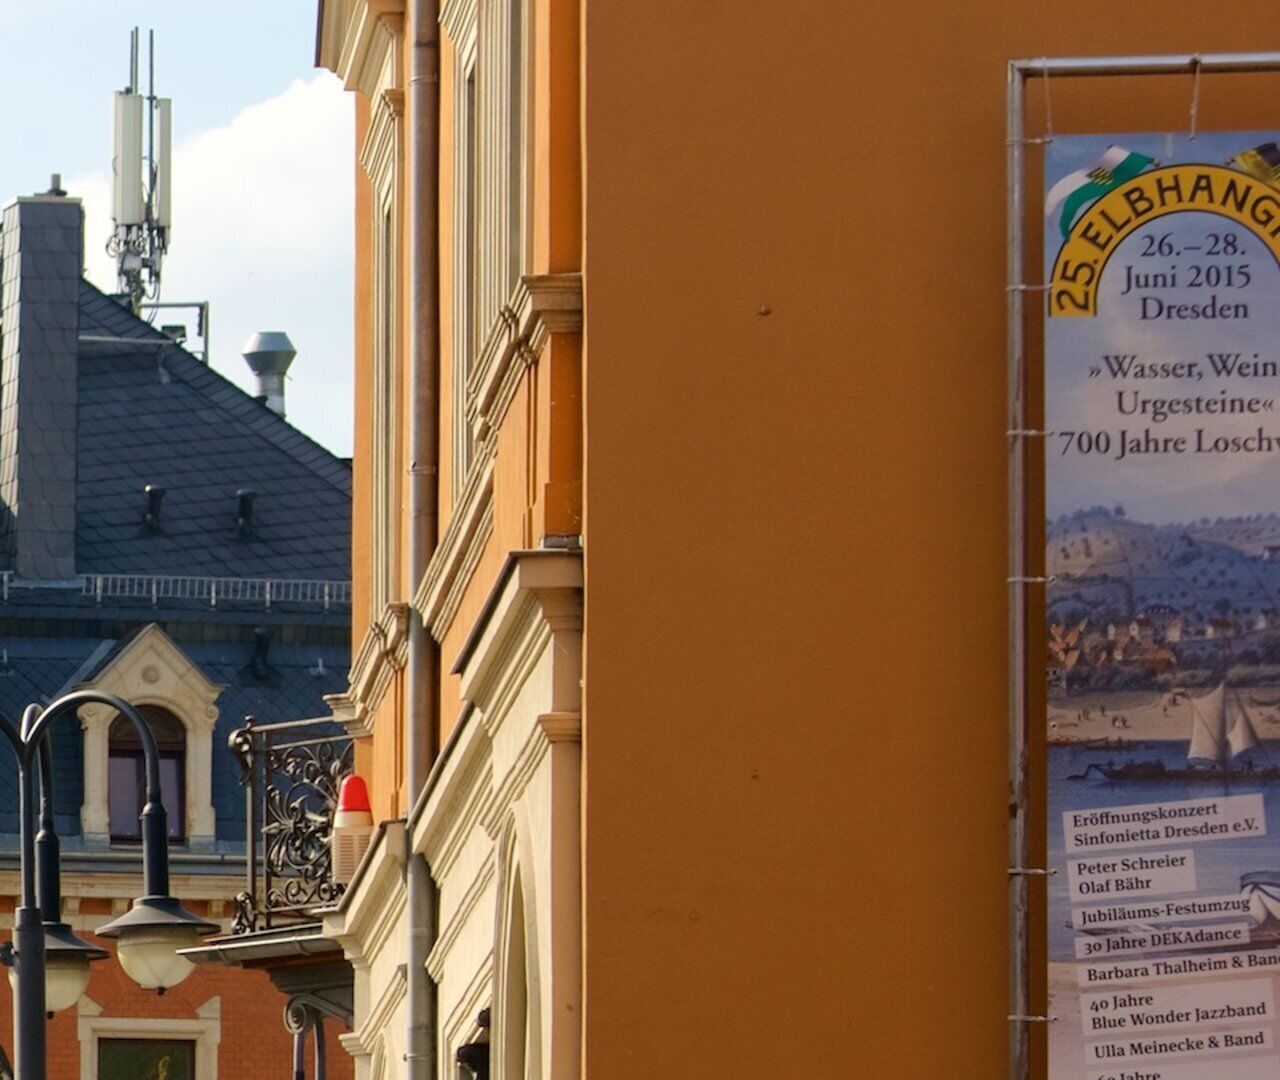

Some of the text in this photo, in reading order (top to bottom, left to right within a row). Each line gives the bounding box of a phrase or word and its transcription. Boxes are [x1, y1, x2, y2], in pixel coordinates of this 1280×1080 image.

[1120, 264, 1251, 295] Juni 2015
[1140, 295, 1249, 320] Dresden
[1089, 354, 1203, 381] »Wasser,
[1117, 389, 1274, 423] Urgesteine«
[1058, 430, 1111, 456] 700
[1115, 428, 1187, 461] Jahre
[1072, 803, 1218, 828] Eröffnungskonzert
[1074, 818, 1259, 847] Sinfonietta Dresden e.V.
[1077, 855, 1186, 875] Peter Schreier
[1079, 877, 1152, 895] Olaf Bähr
[1081, 899, 1251, 925] Jubiläums-Festumzug
[1084, 928, 1241, 955] 30 Jahre DEKAdance
[1087, 964, 1149, 982] Barbara
[1153, 958, 1228, 976] Thalheim
[1231, 957, 1244, 968] &
[1089, 994, 1154, 1013] 40 Jahre
[1092, 1002, 1267, 1030] Blue Wonder Jazzband
[1094, 1031, 1265, 1059] Ulla Meinecke & Band
